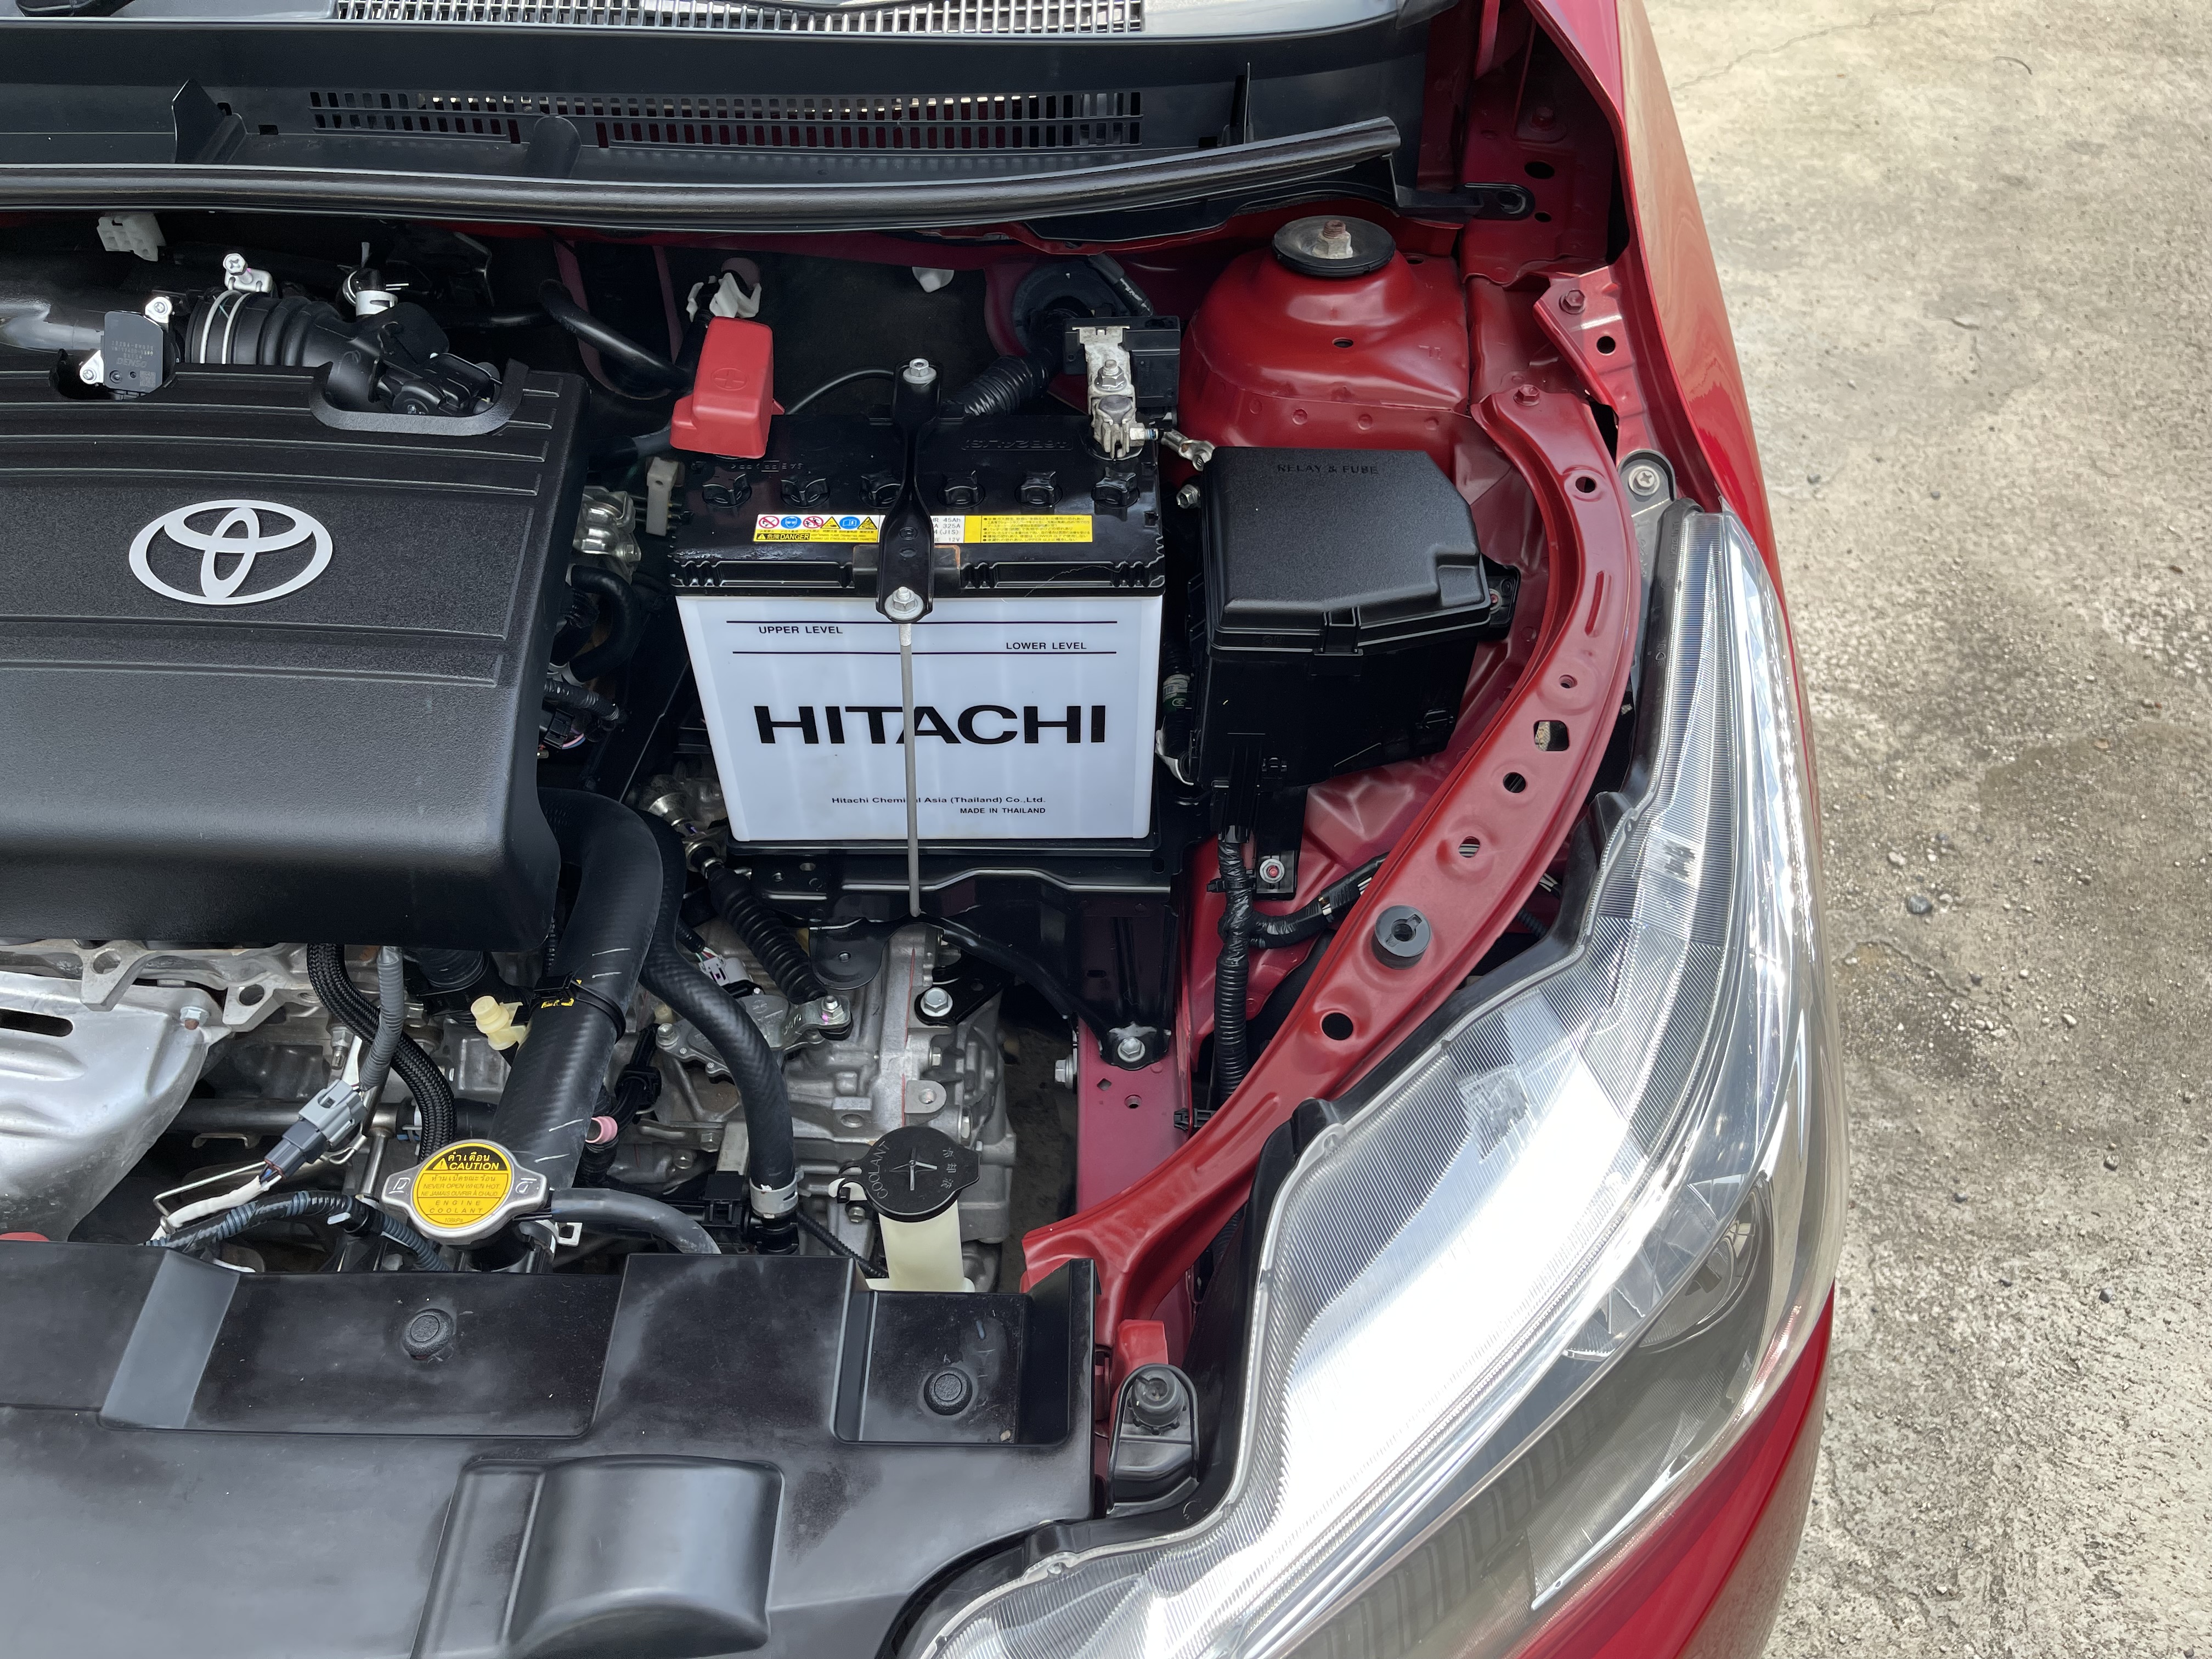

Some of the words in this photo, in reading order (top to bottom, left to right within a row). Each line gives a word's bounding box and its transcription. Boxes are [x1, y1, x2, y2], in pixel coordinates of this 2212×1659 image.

[116, 357, 148, 368] DENSO
[1328, 465, 1338, 474] &
[805, 626, 843, 634] LEVEL
[753, 704, 1106, 744] HITACHI
[449, 1162, 499, 1170] CAUTION
[868, 1141, 890, 1199] COOLANT
